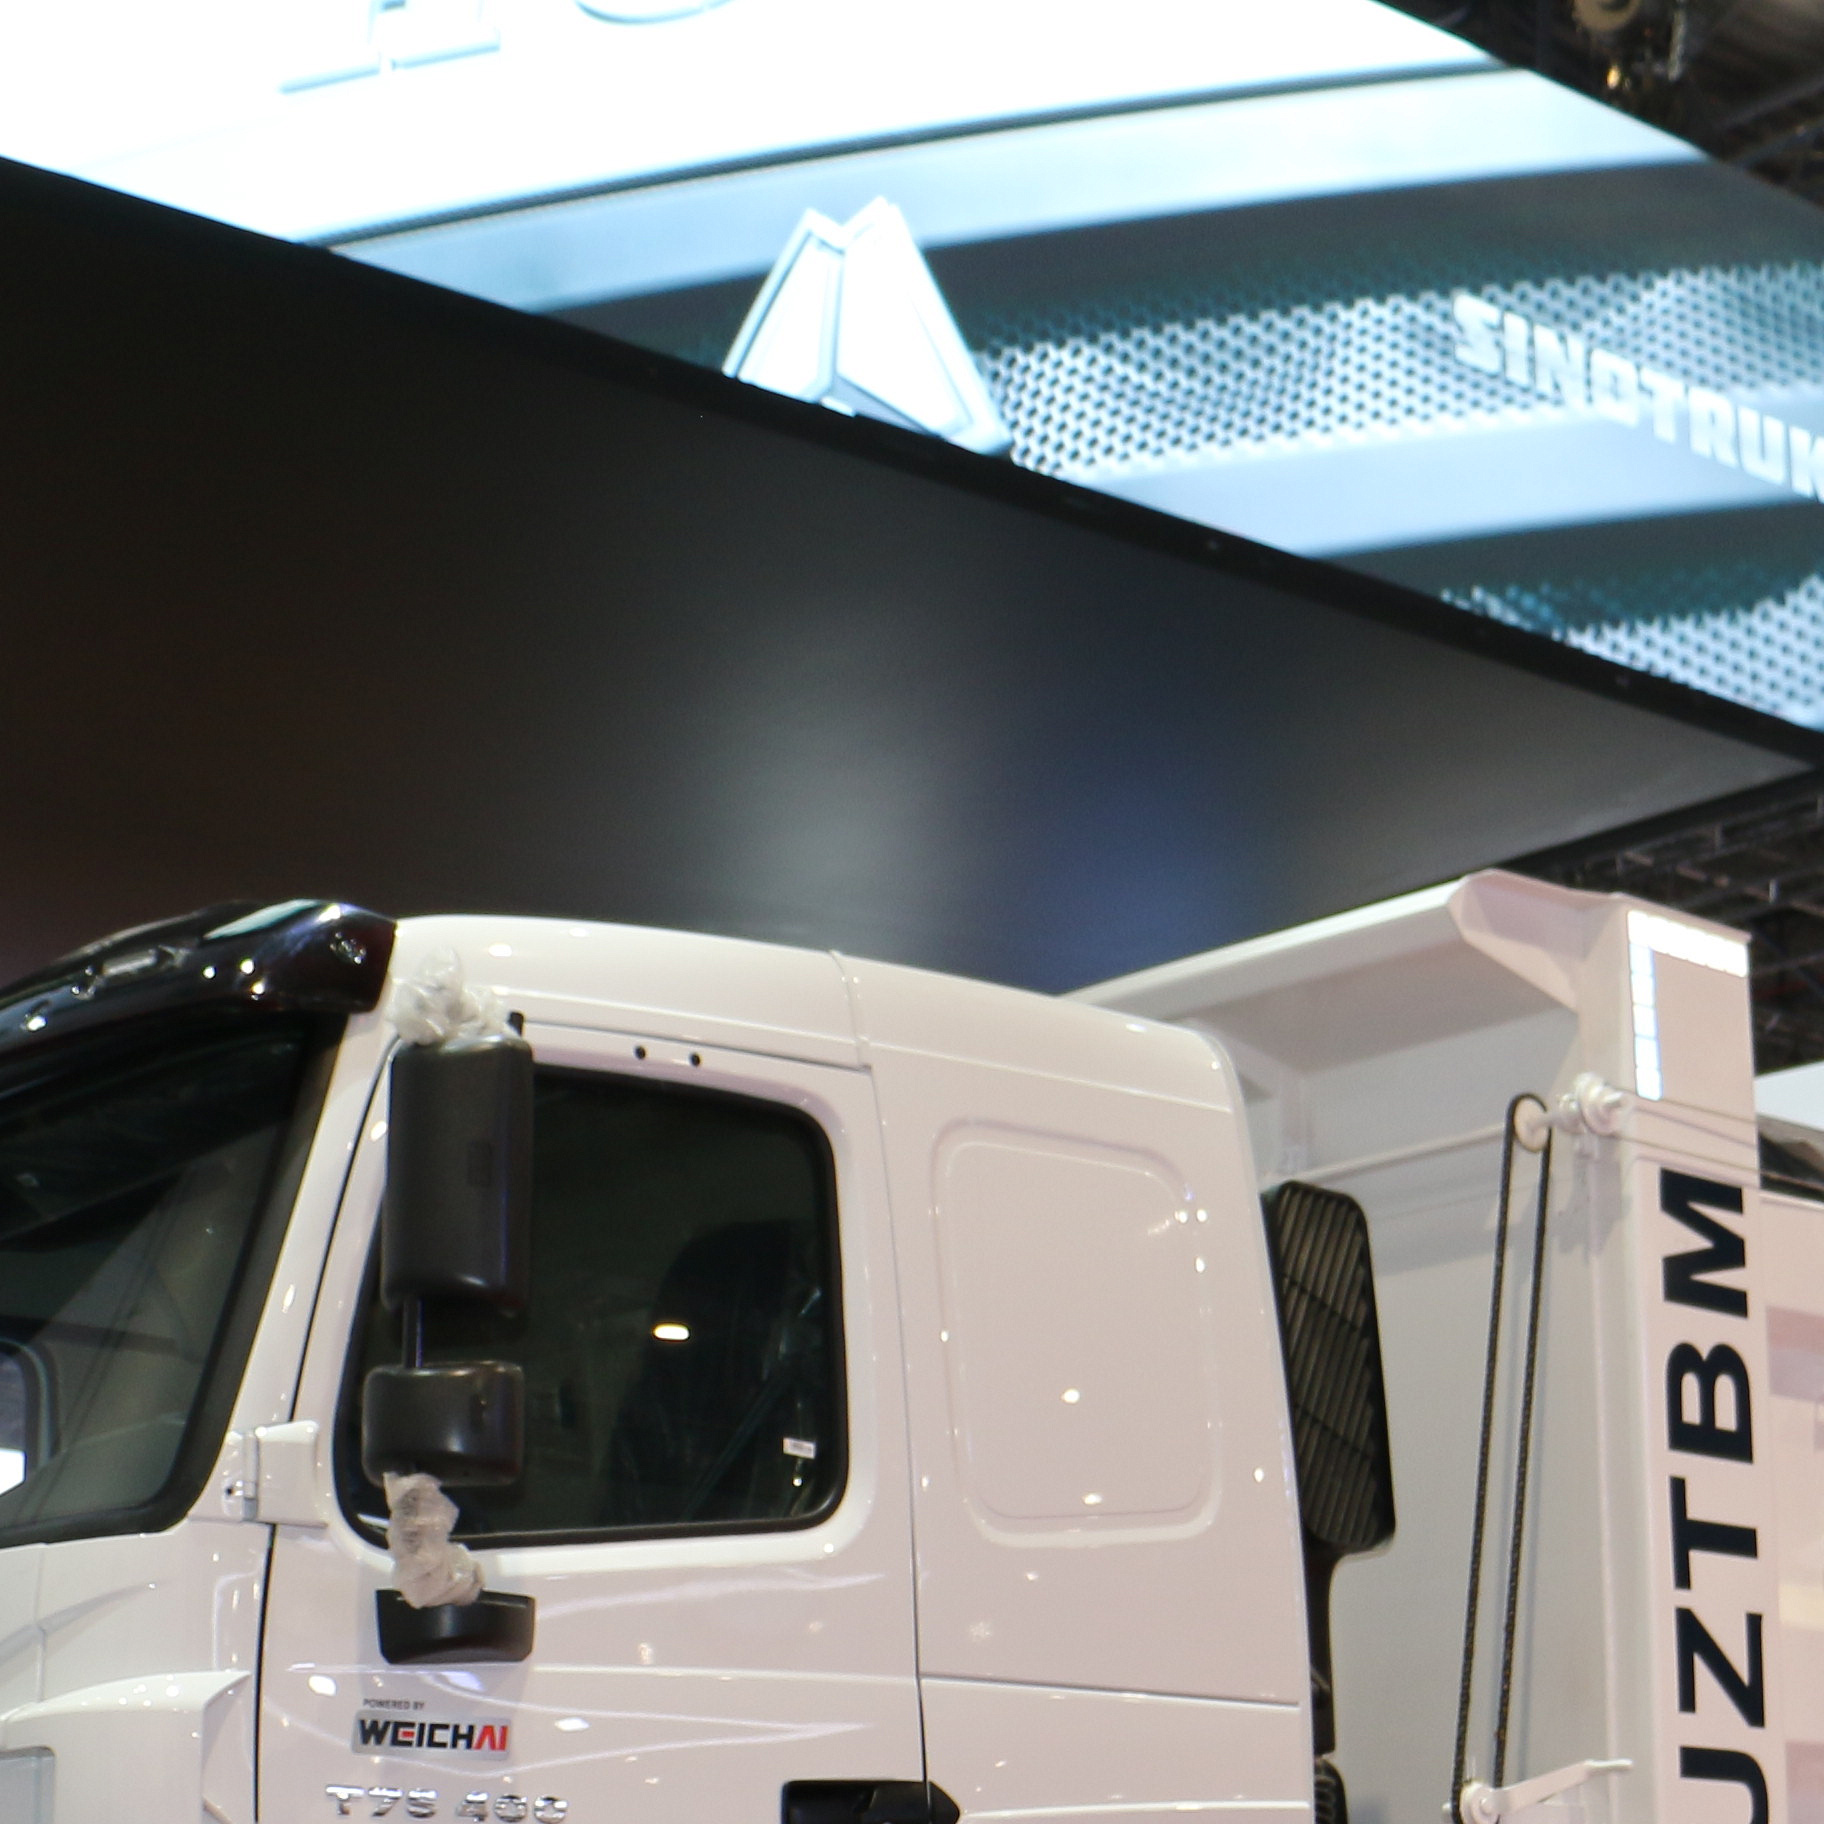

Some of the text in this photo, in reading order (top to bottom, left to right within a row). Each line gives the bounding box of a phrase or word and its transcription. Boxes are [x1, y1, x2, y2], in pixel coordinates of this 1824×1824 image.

[363, 1698, 425, 1711] POWERED BY
[358, 1718, 509, 1752] WEICHAI
